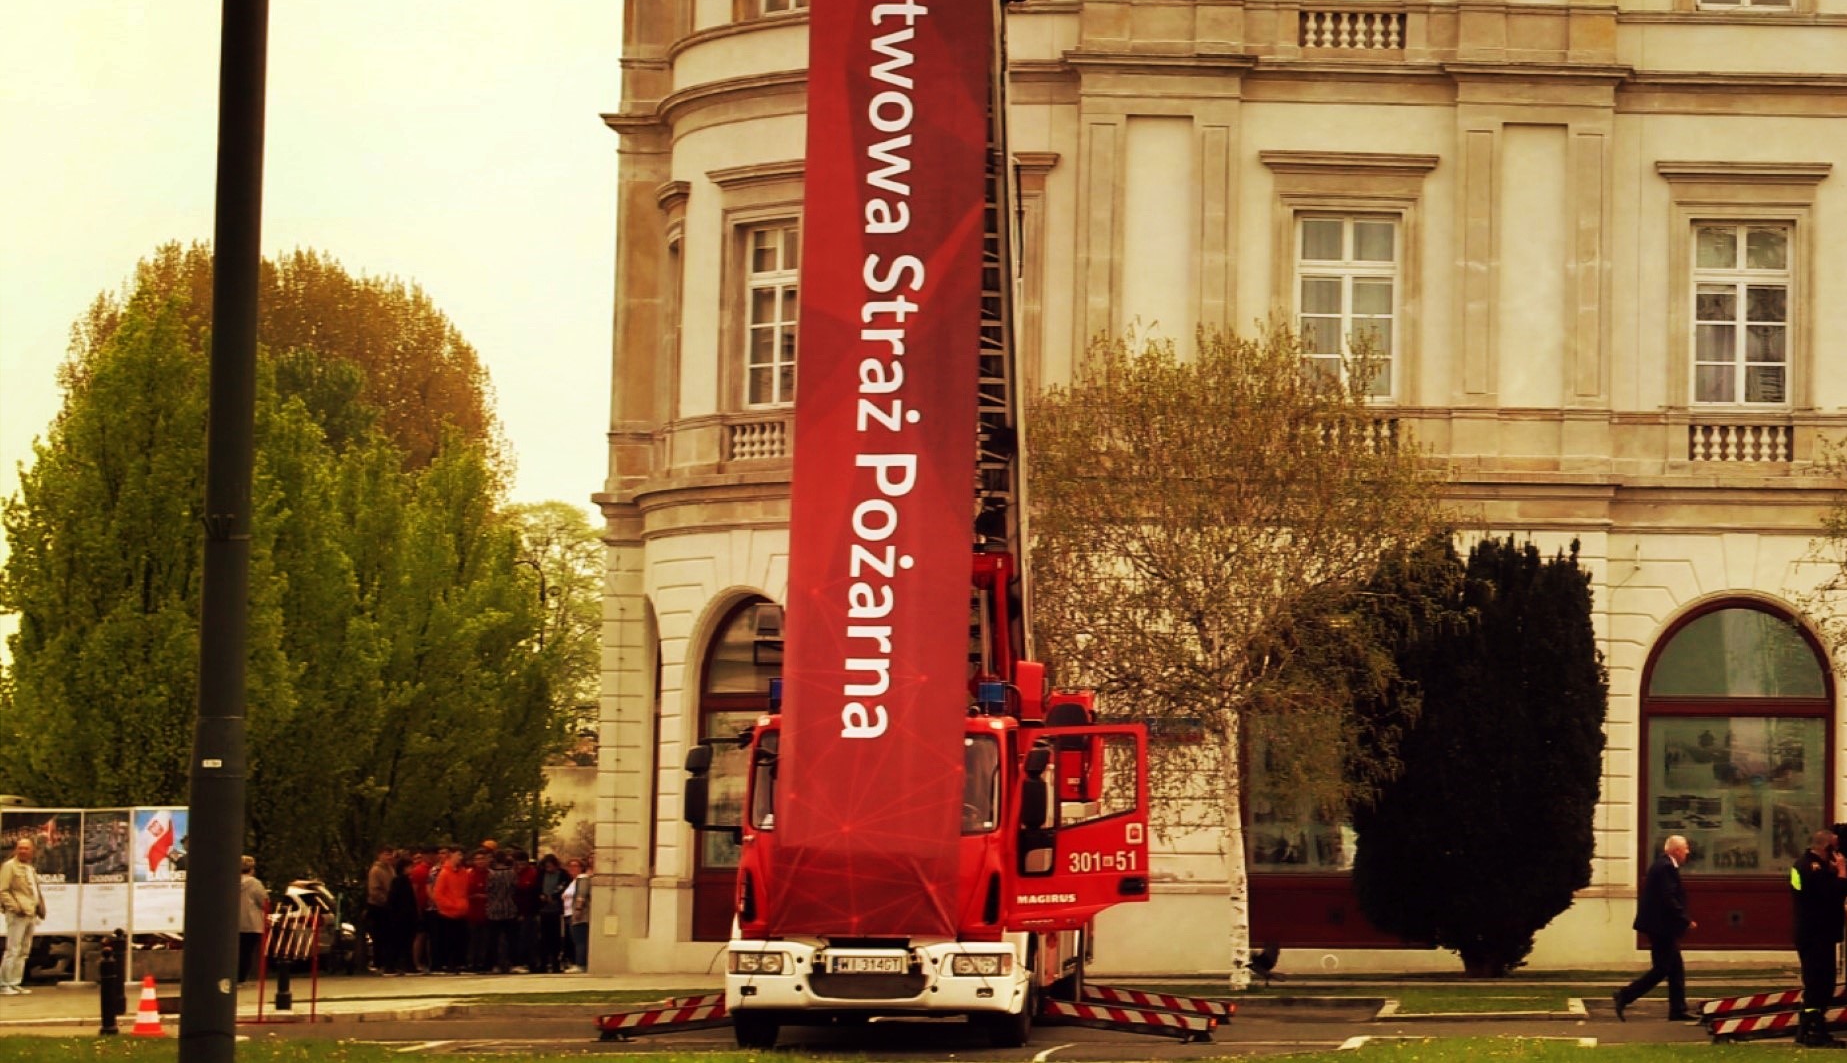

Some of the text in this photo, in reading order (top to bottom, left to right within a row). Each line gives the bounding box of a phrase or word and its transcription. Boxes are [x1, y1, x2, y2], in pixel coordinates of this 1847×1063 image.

[856, 253, 926, 432] Straż
[841, 453, 920, 739] Pożarna
[1016, 894, 1077, 904] MAGIRUS
[1069, 851, 1137, 872] 301 51
